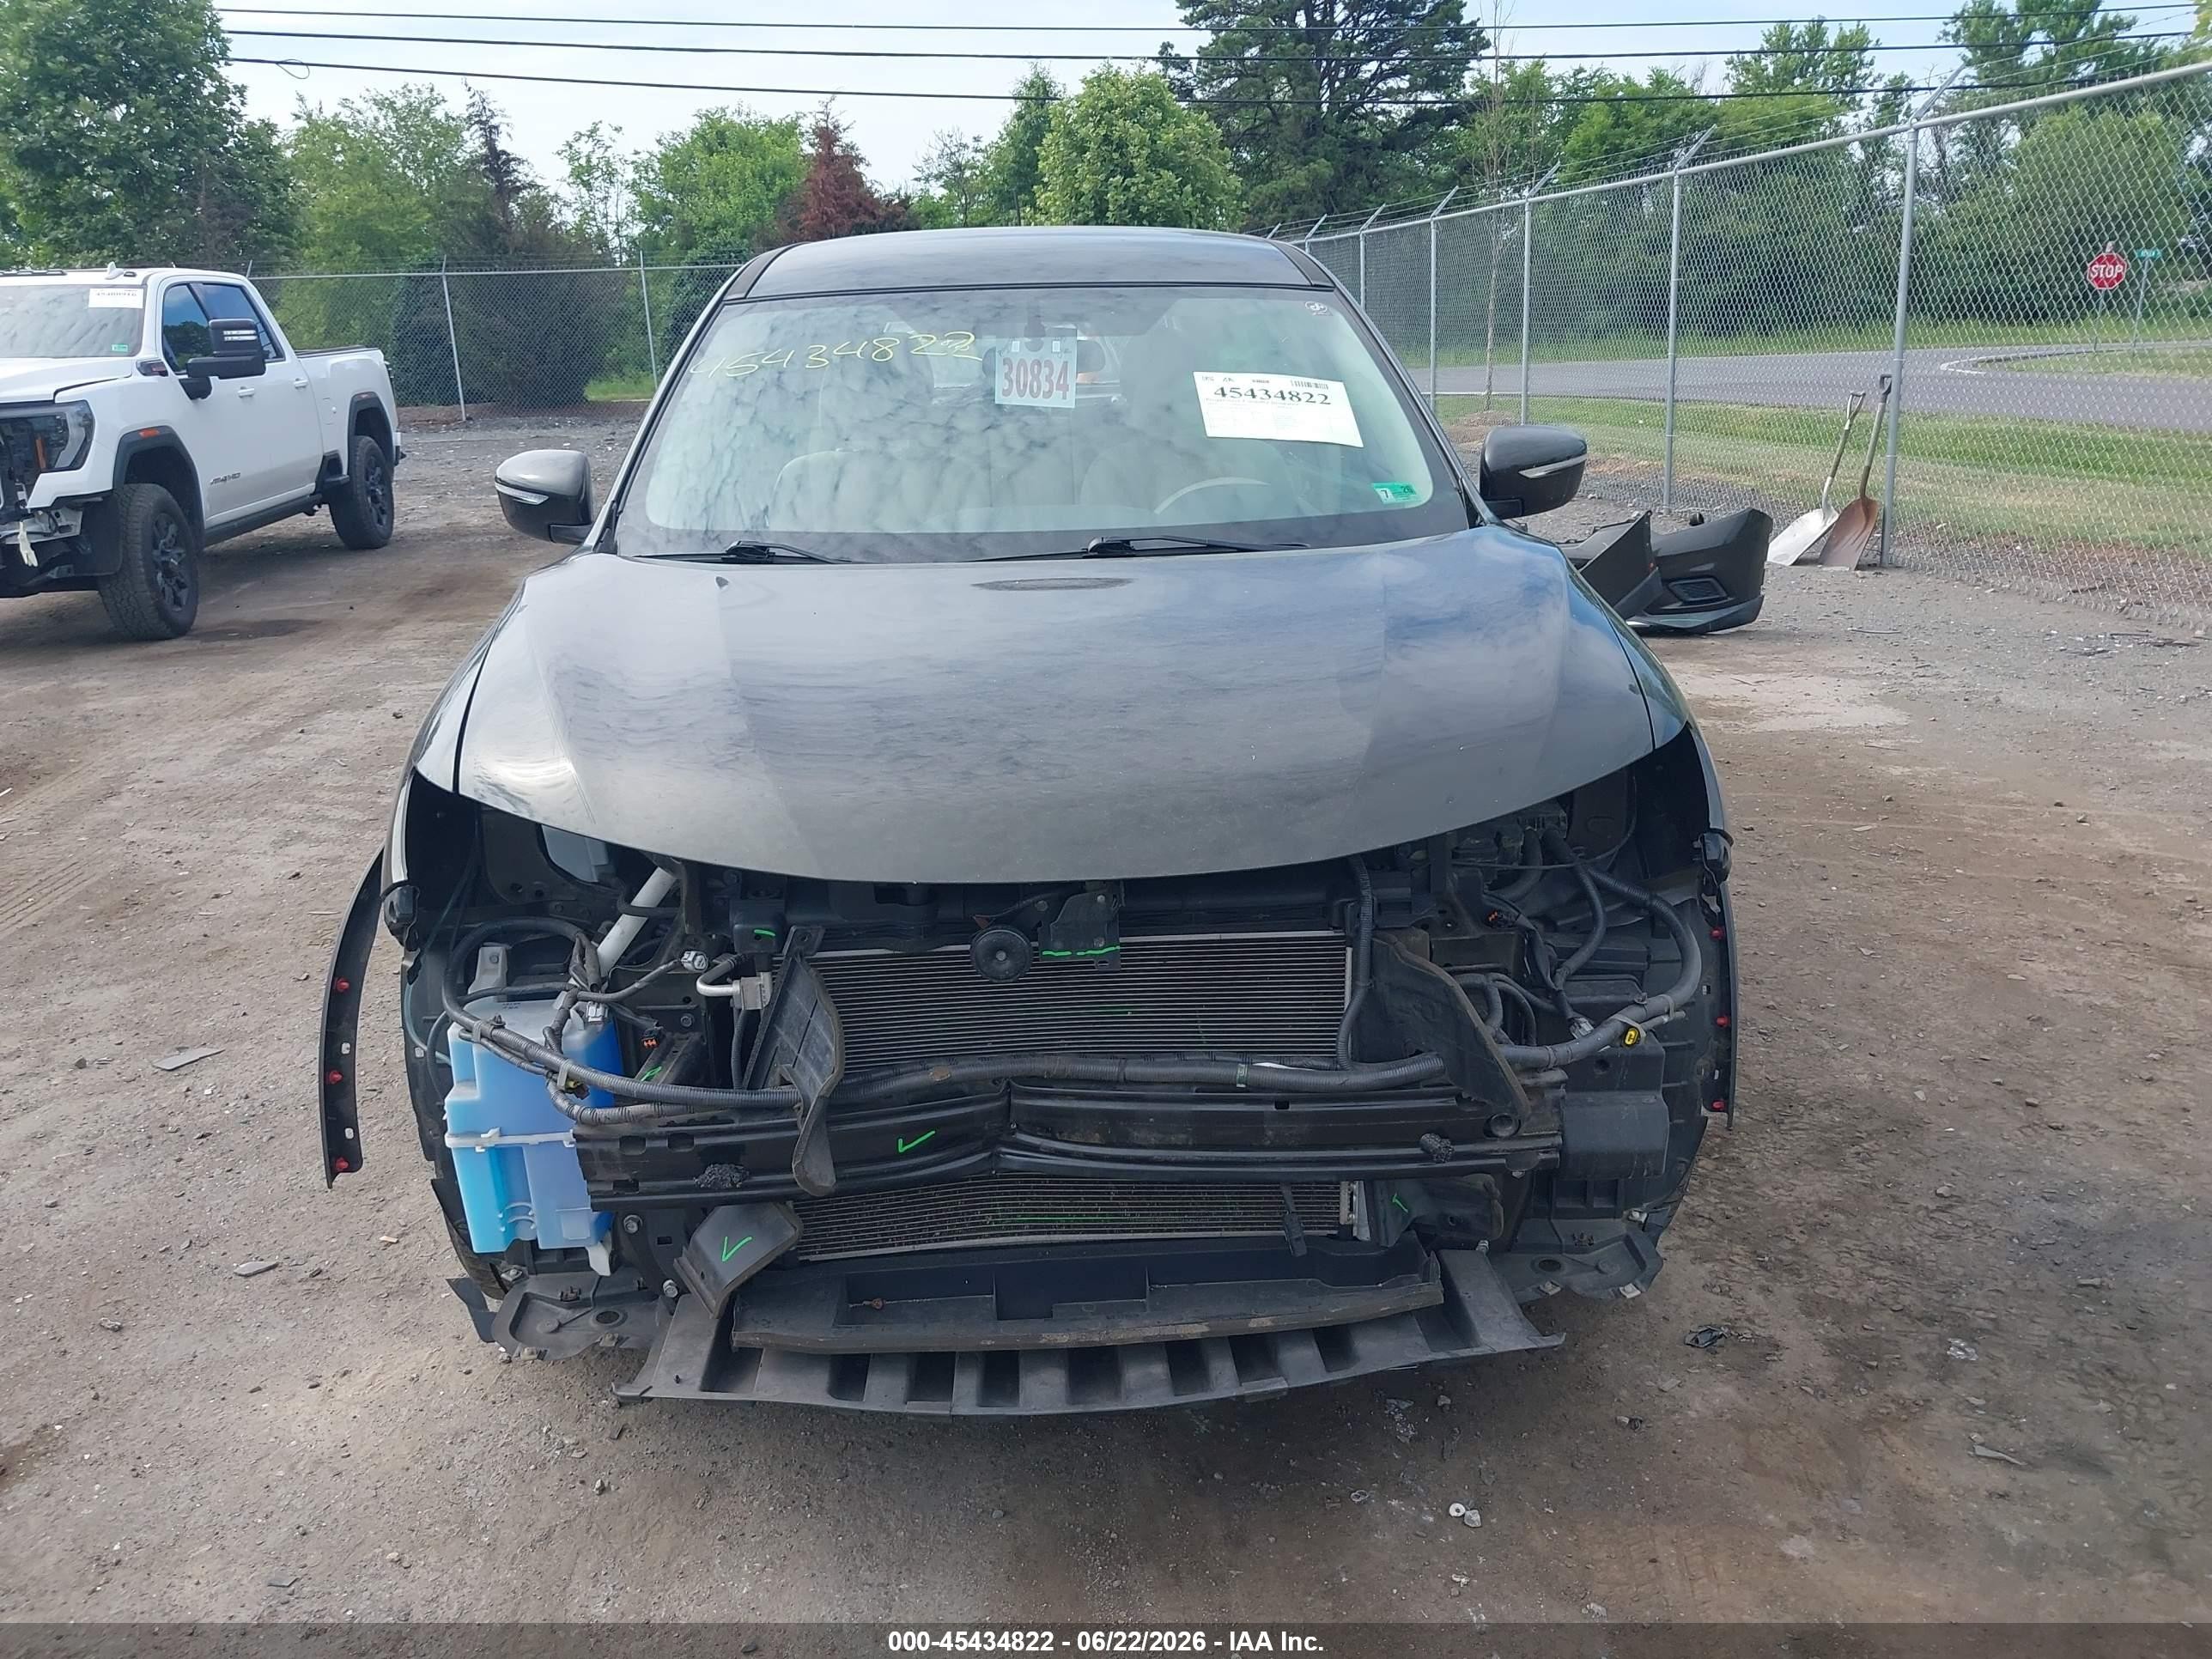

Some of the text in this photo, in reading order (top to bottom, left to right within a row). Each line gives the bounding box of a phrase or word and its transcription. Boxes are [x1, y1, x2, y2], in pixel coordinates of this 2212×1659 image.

[2089, 264, 2124, 278] STOP
[689, 331, 983, 379] 45434822
[1001, 357, 1070, 400] 30834
[1213, 386, 1332, 405] 45434822
